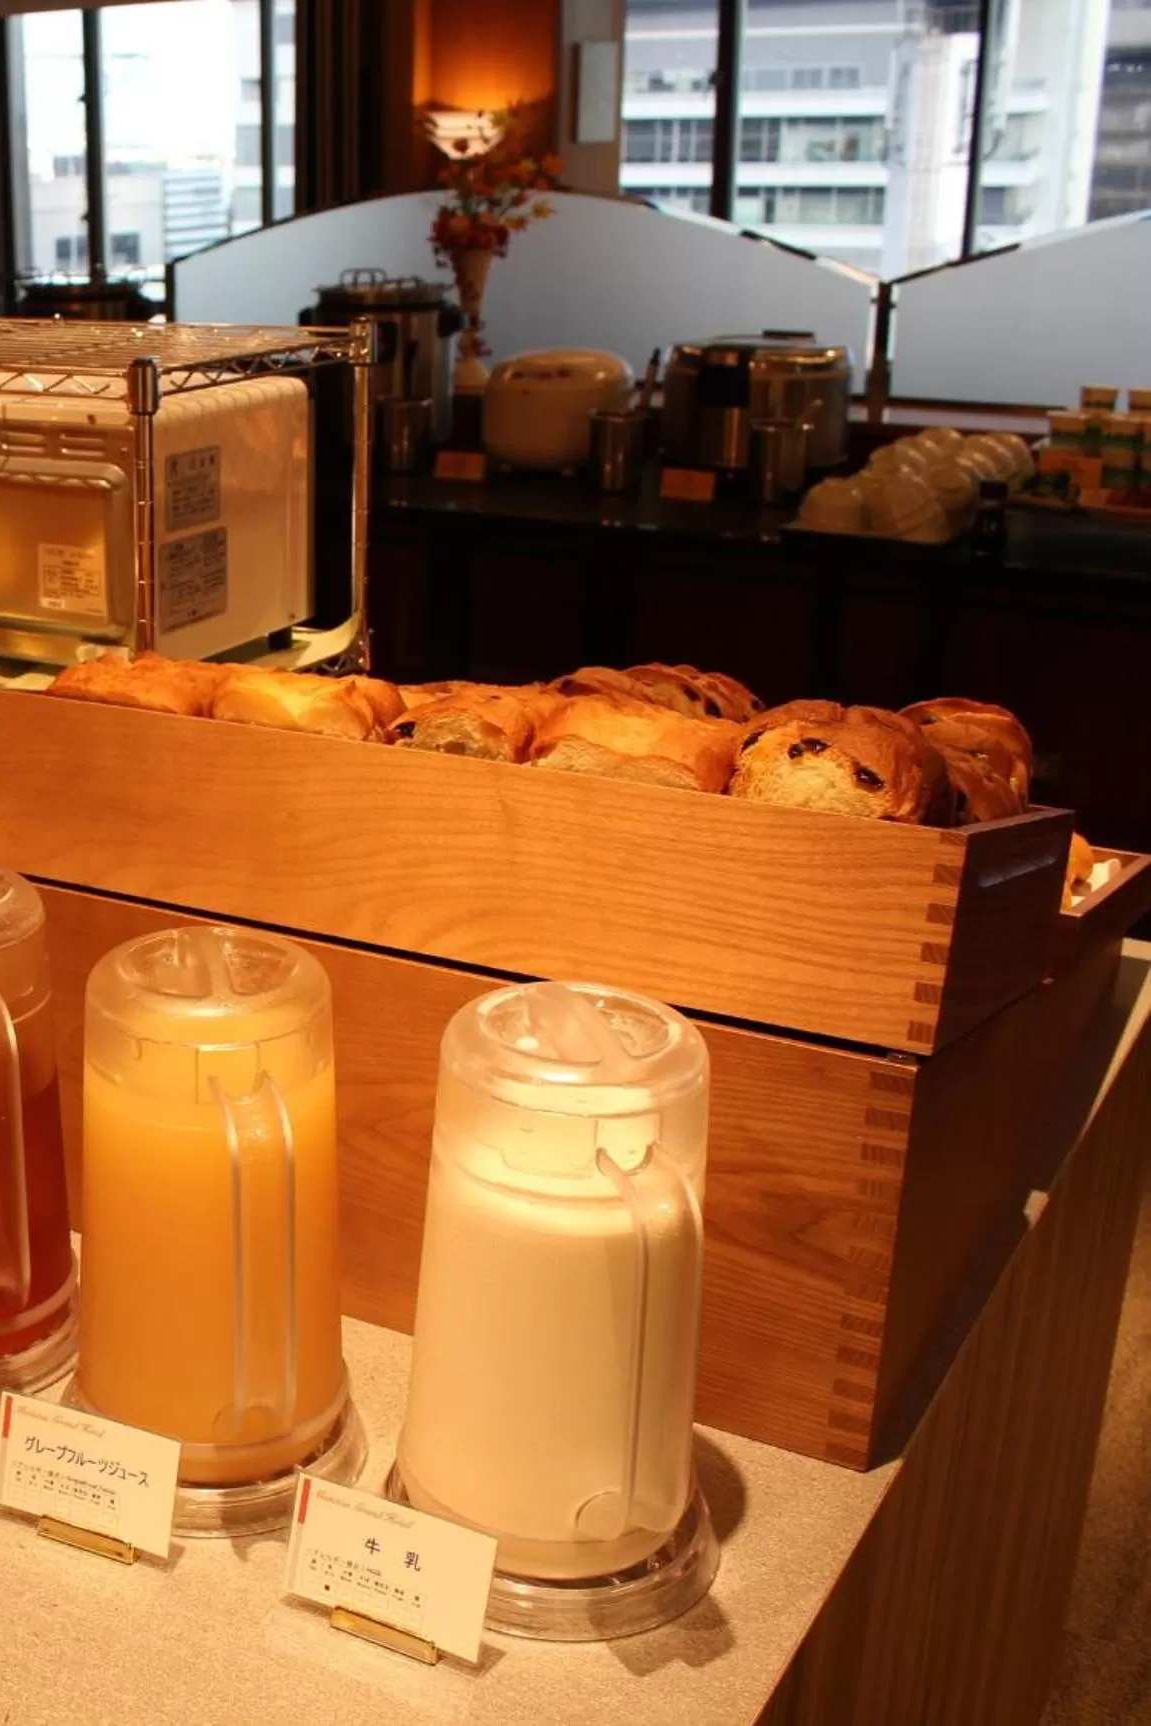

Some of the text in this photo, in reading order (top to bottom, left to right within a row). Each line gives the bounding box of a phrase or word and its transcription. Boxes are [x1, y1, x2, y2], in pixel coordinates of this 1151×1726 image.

[24, 1436, 150, 1488] グレープフルーツジュース
